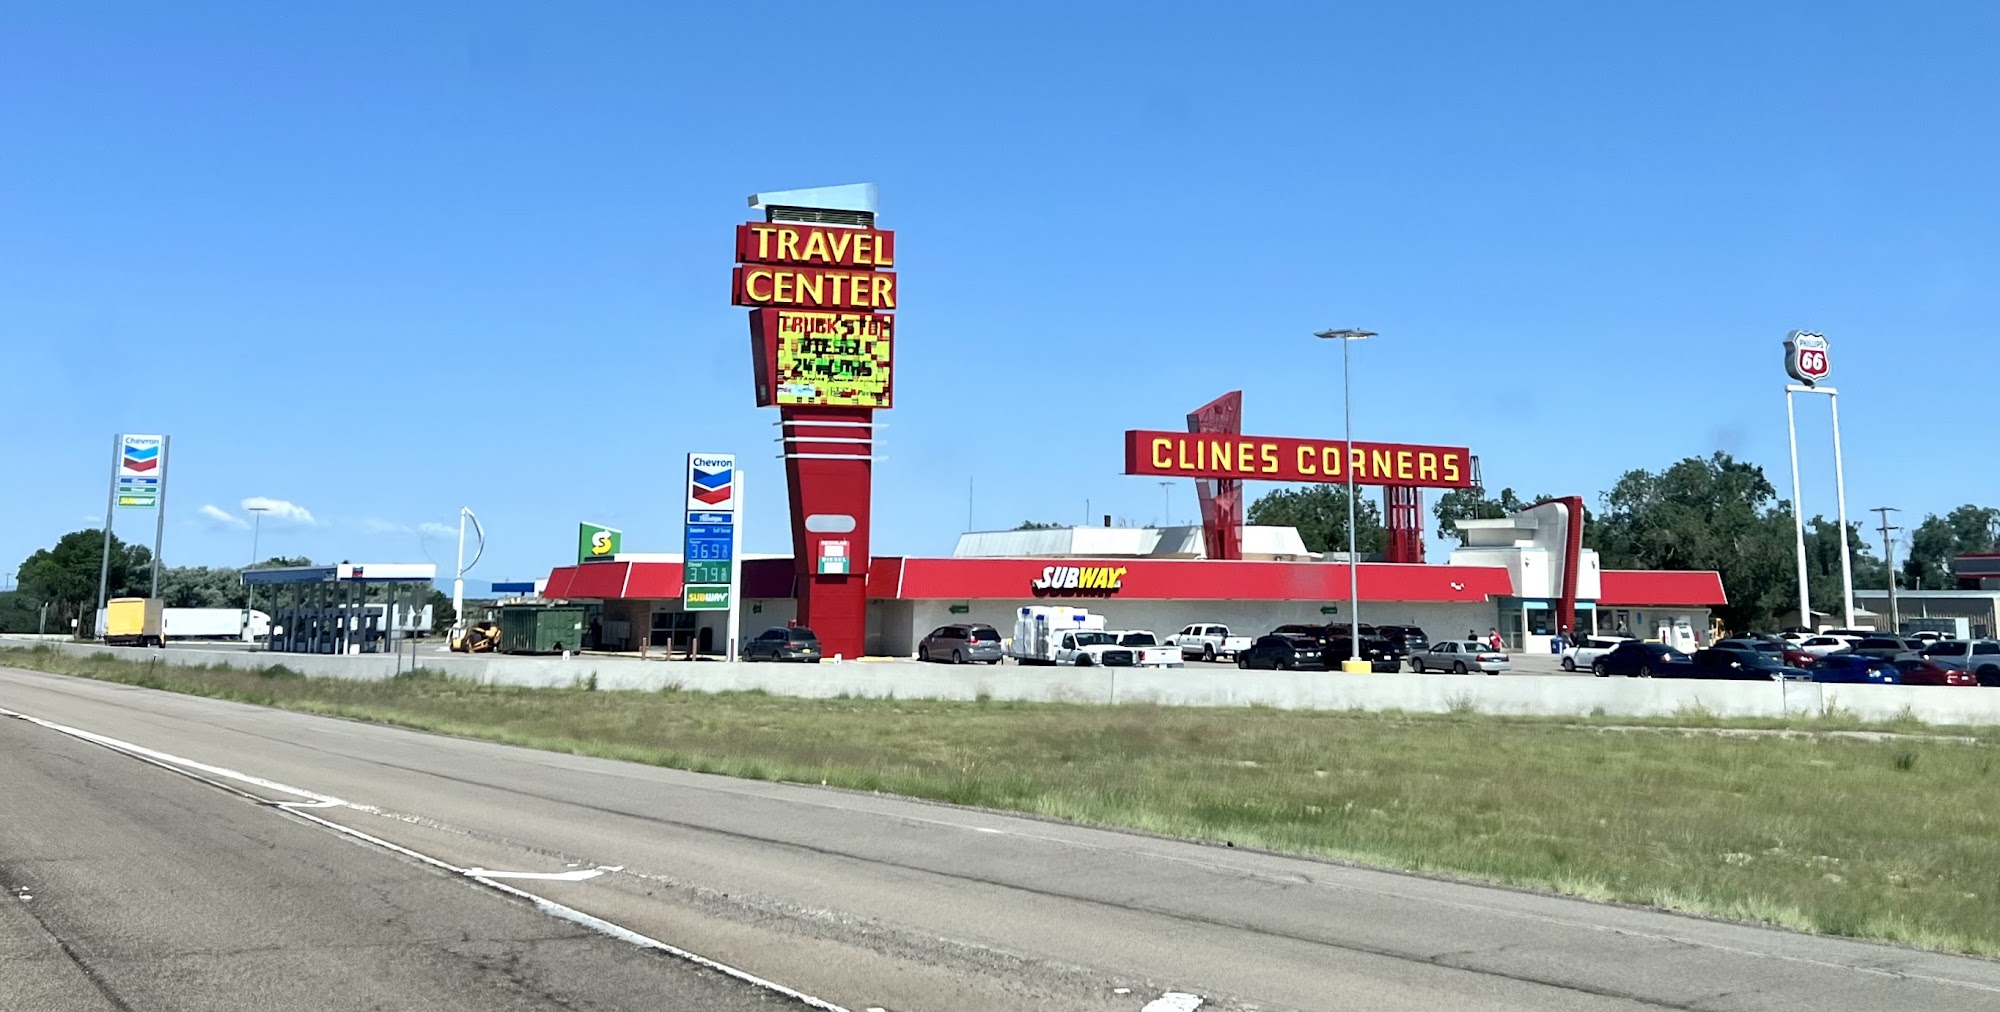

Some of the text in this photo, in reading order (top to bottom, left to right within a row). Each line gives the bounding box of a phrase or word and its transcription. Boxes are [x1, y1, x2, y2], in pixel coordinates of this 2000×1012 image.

[751, 226, 893, 266] TRAVEL
[746, 270, 895, 308] CENTER
[1802, 351, 1824, 371] 66
[124, 437, 160, 445] Chevron
[693, 457, 733, 468] Chevron
[1152, 437, 1459, 482] CLINES CORNERS
[1032, 565, 1127, 589] SUBWAY
[688, 592, 729, 603] SUBWAY
